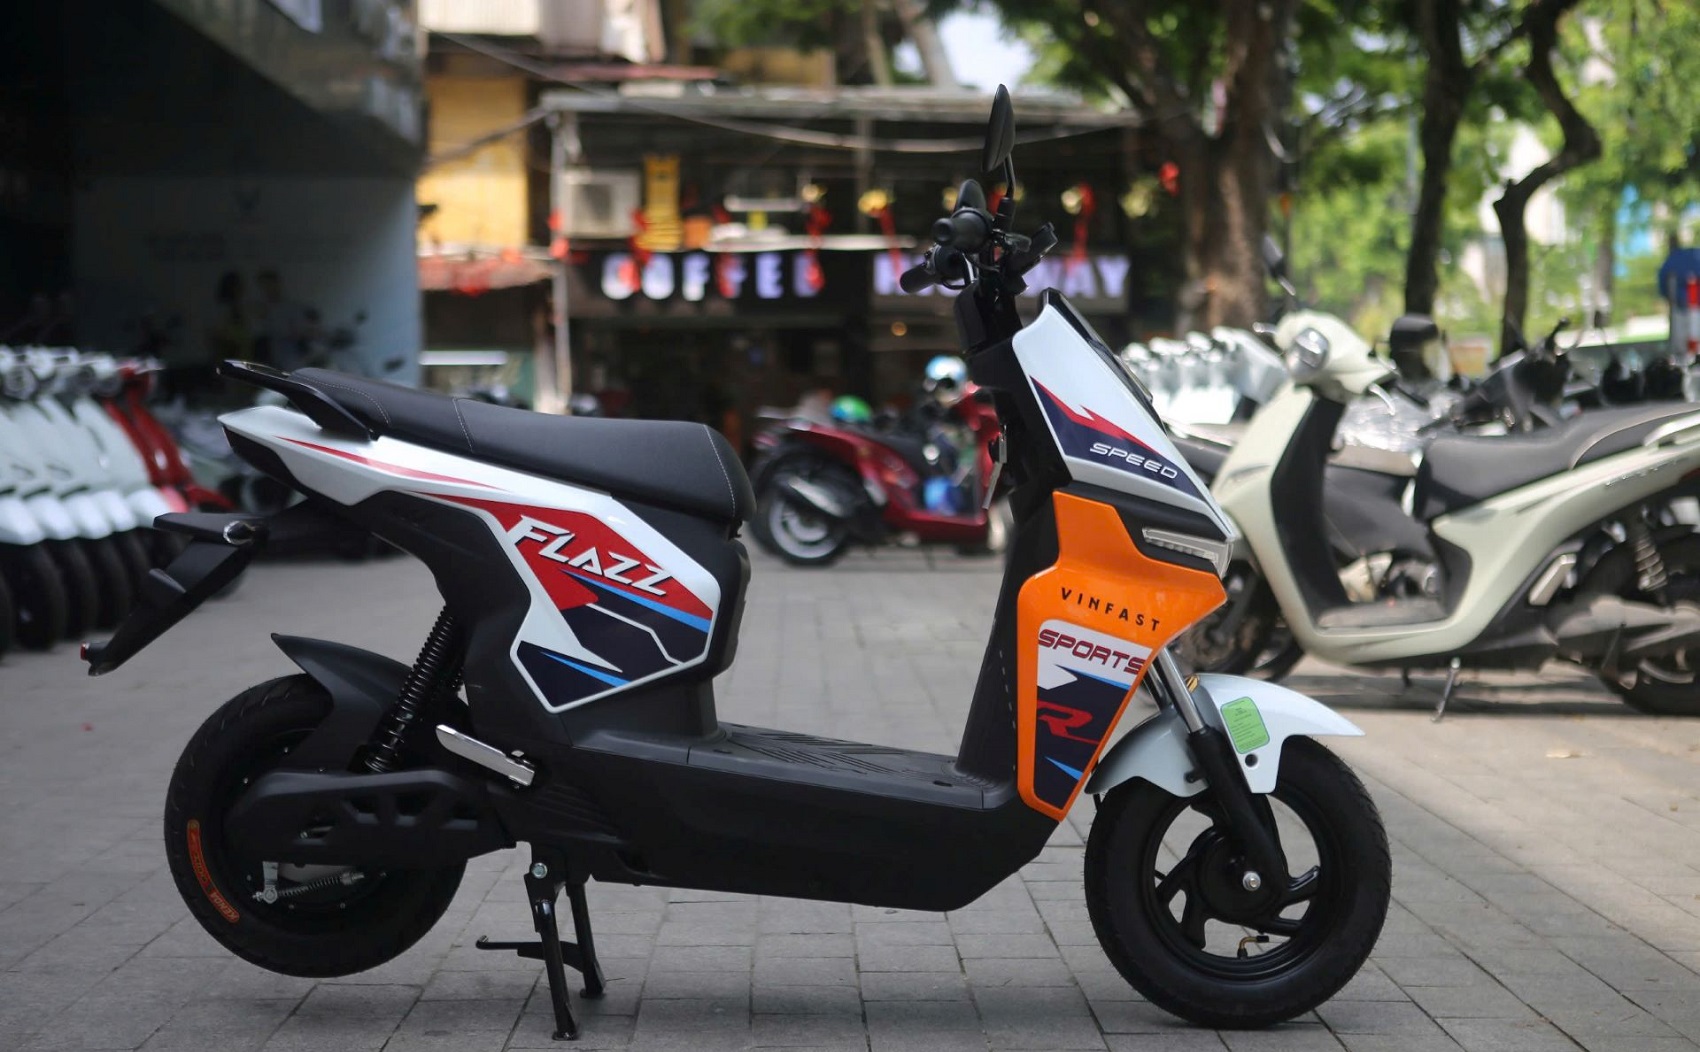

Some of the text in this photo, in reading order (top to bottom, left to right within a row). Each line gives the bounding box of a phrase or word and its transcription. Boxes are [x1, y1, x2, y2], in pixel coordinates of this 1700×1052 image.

[1090, 443, 1178, 479] SPEED
[507, 514, 674, 597] FLAZZ
[1061, 587, 1160, 631] VINFAST
[1038, 628, 1146, 675] SPORTS
[1037, 699, 1099, 745] R
